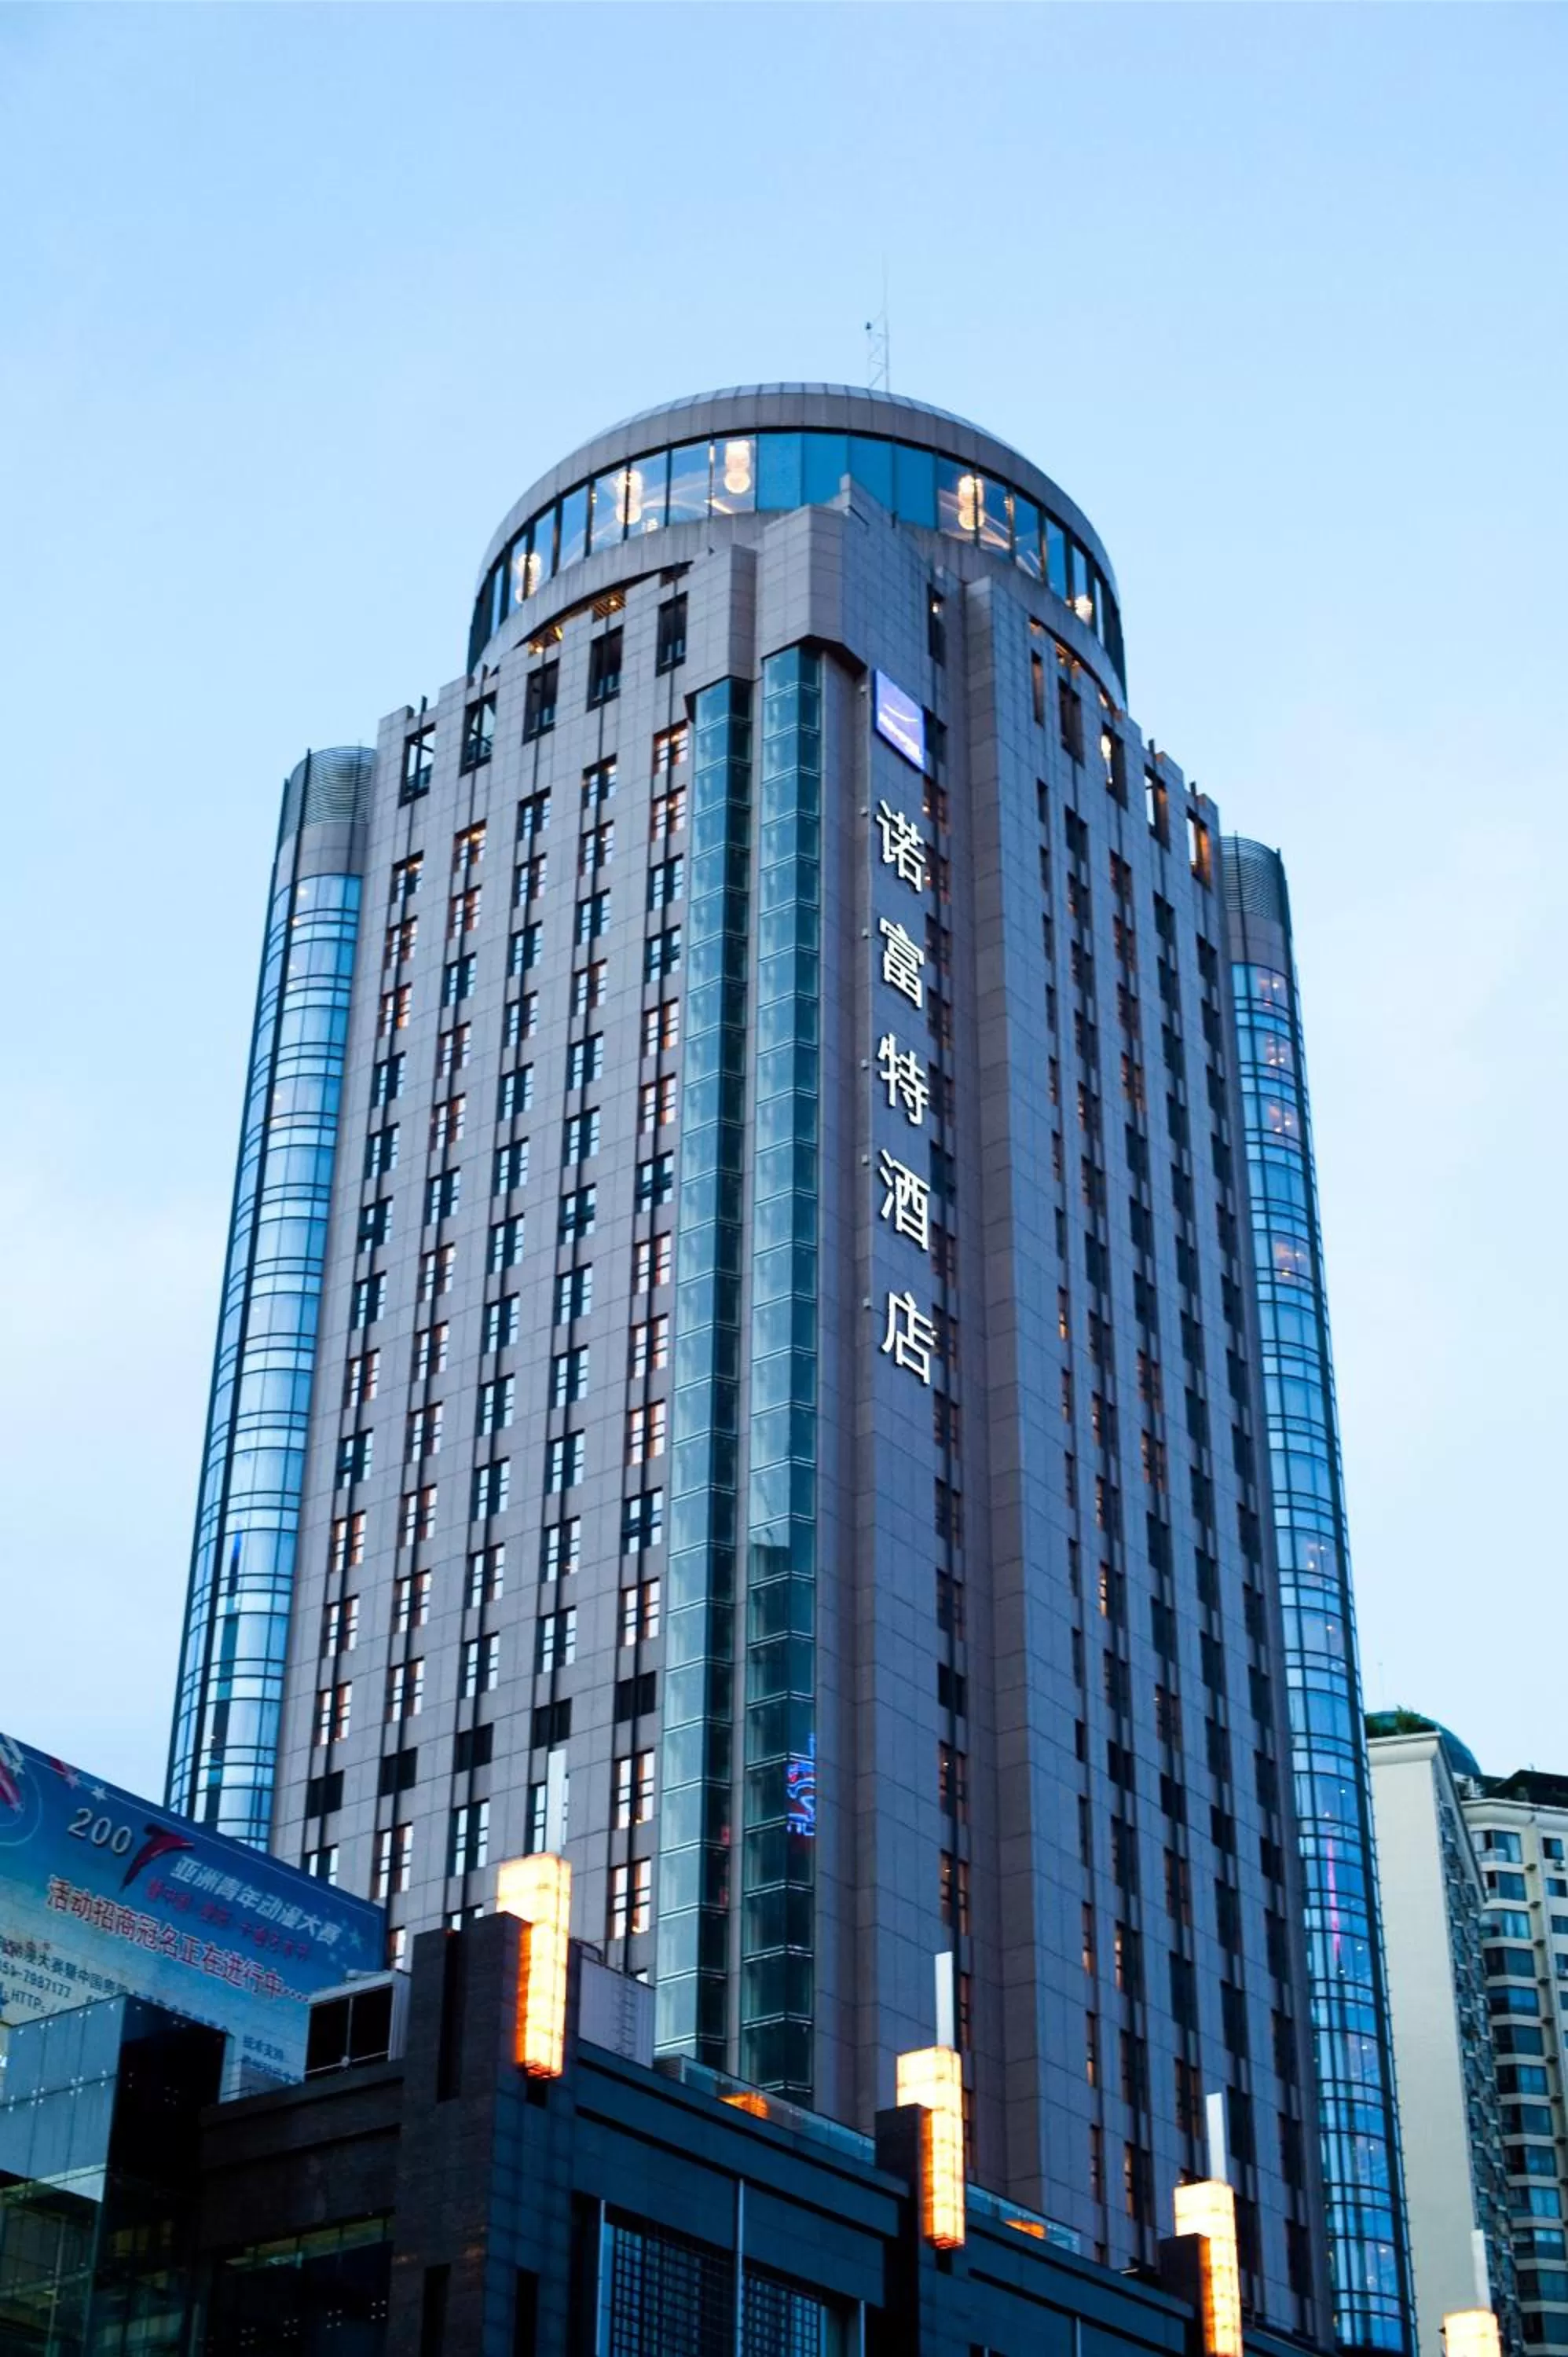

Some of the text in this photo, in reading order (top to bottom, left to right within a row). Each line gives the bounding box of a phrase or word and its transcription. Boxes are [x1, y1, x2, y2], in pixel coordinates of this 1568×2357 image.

[876, 799, 935, 1386] 诺富特酒店
